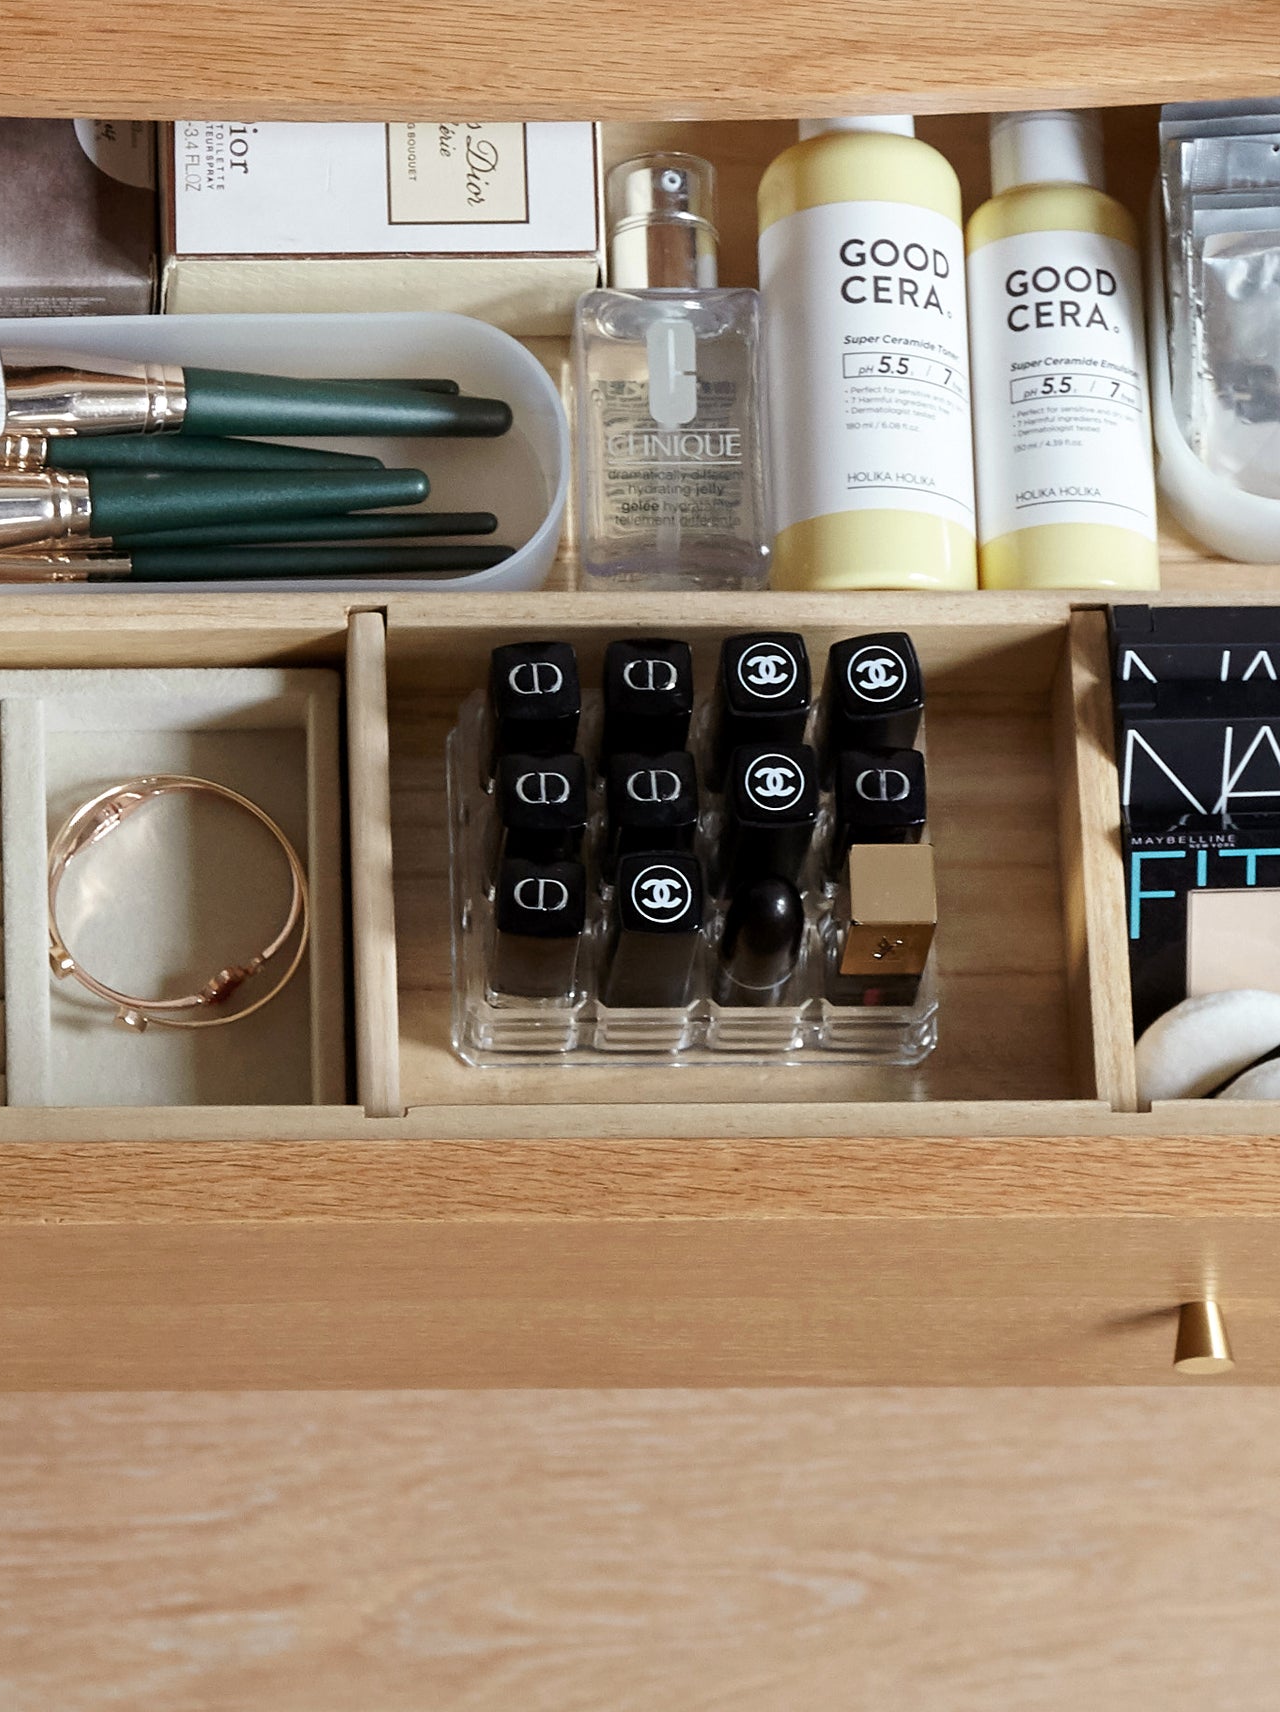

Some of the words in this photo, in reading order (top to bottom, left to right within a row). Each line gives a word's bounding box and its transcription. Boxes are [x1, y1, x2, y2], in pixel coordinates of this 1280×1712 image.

[205, 121, 214, 152] TEUR
[229, 121, 259, 175] ior
[438, 122, 460, 158] érie
[215, 124, 225, 191] TOILETTE
[406, 131, 417, 181] BOUQUET
[205, 155, 215, 190] SPRAY
[465, 135, 499, 207] Dior
[839, 237, 950, 280] GOOD
[1004, 264, 1118, 299] GOOD
[843, 334, 880, 347] Super
[881, 334, 936, 352] Ceramide
[858, 365, 874, 377] pH
[943, 367, 953, 386] 7
[1010, 358, 1043, 373] Super
[1043, 356, 1099, 368] Ceramide
[1022, 388, 1038, 400] pH
[1109, 381, 1121, 398] 7
[606, 433, 743, 461] CLINIQUE
[694, 482, 725, 496] jelly
[846, 471, 893, 484] HOLIKA
[895, 472, 937, 487] HOLIKA
[1015, 487, 1056, 502] HOLIKA
[1058, 485, 1102, 498] HOLIKA
[1130, 834, 1237, 846] MAYBELLINE
